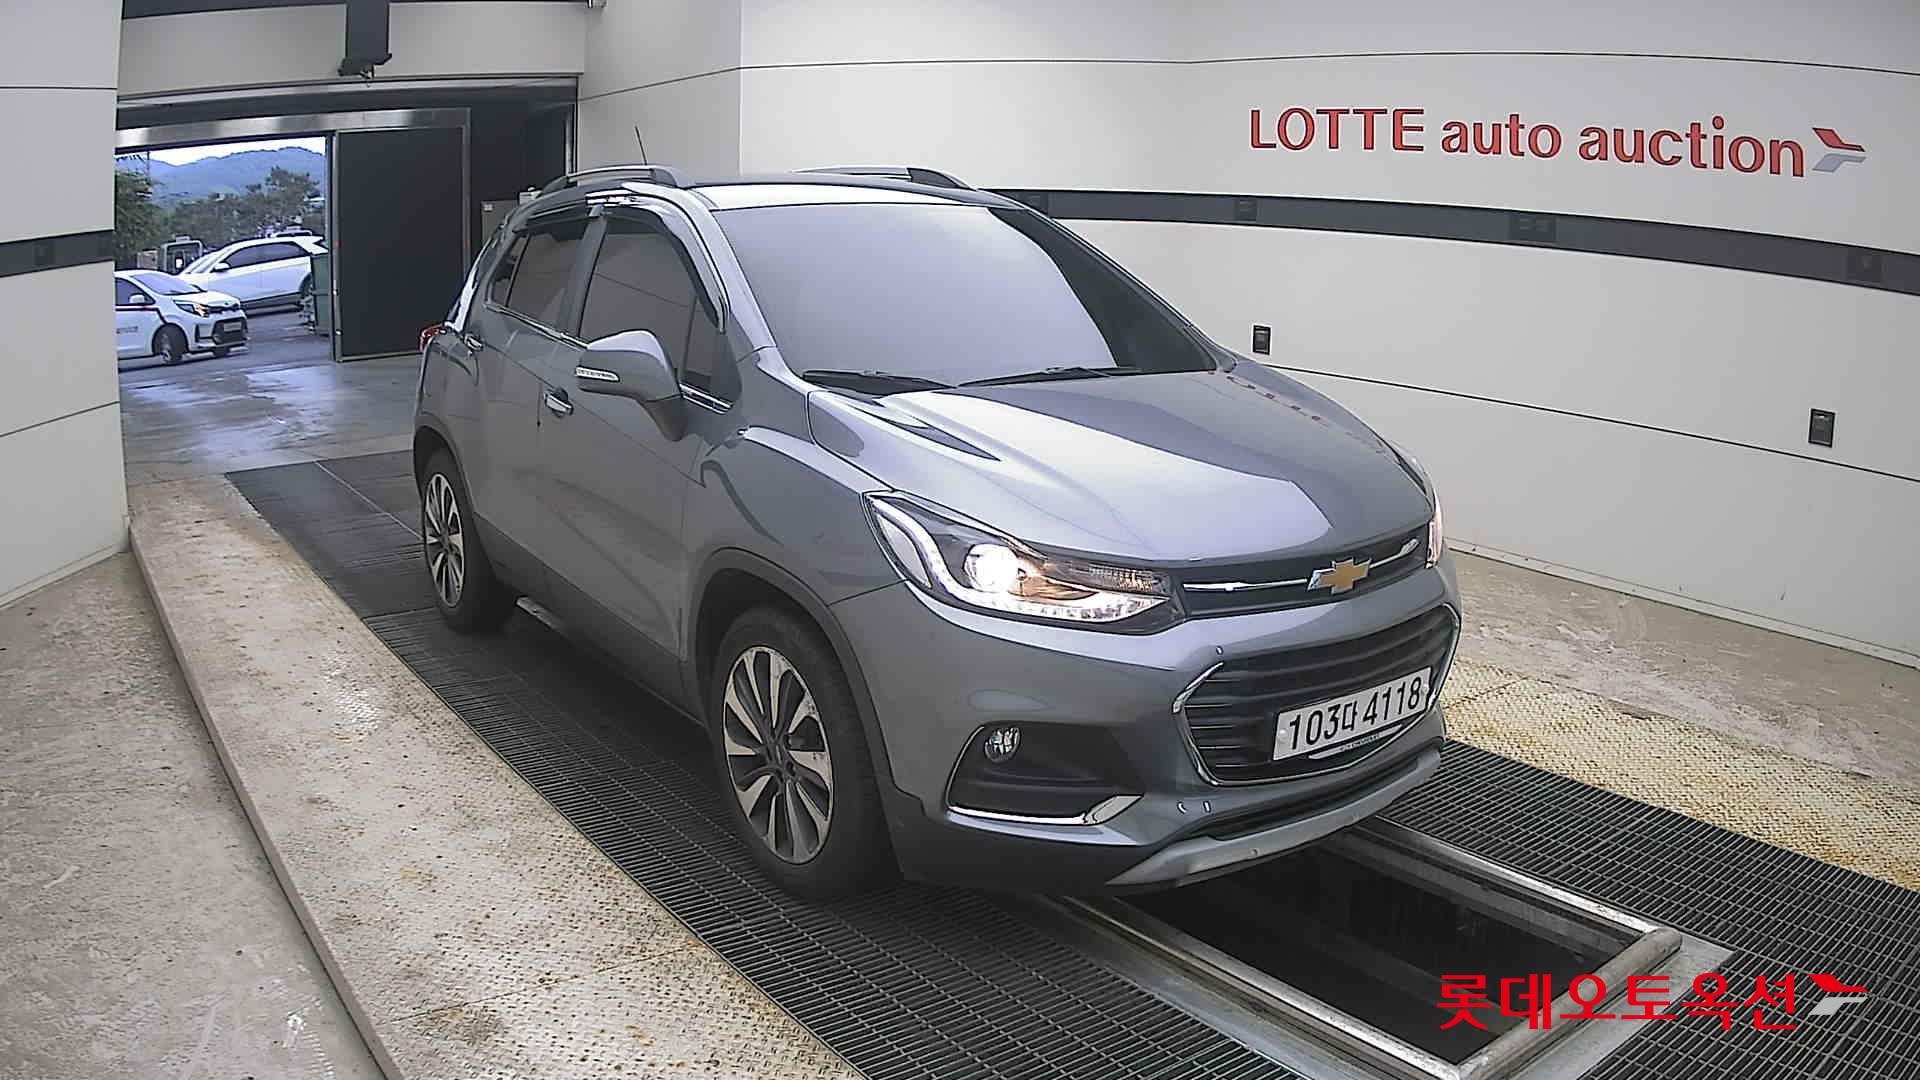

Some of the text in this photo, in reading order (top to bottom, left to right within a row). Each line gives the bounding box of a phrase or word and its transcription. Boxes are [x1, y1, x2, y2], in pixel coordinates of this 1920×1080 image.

[1249, 107, 1806, 178] LOTTE auto auction
[1362, 676, 1422, 726] 4118
